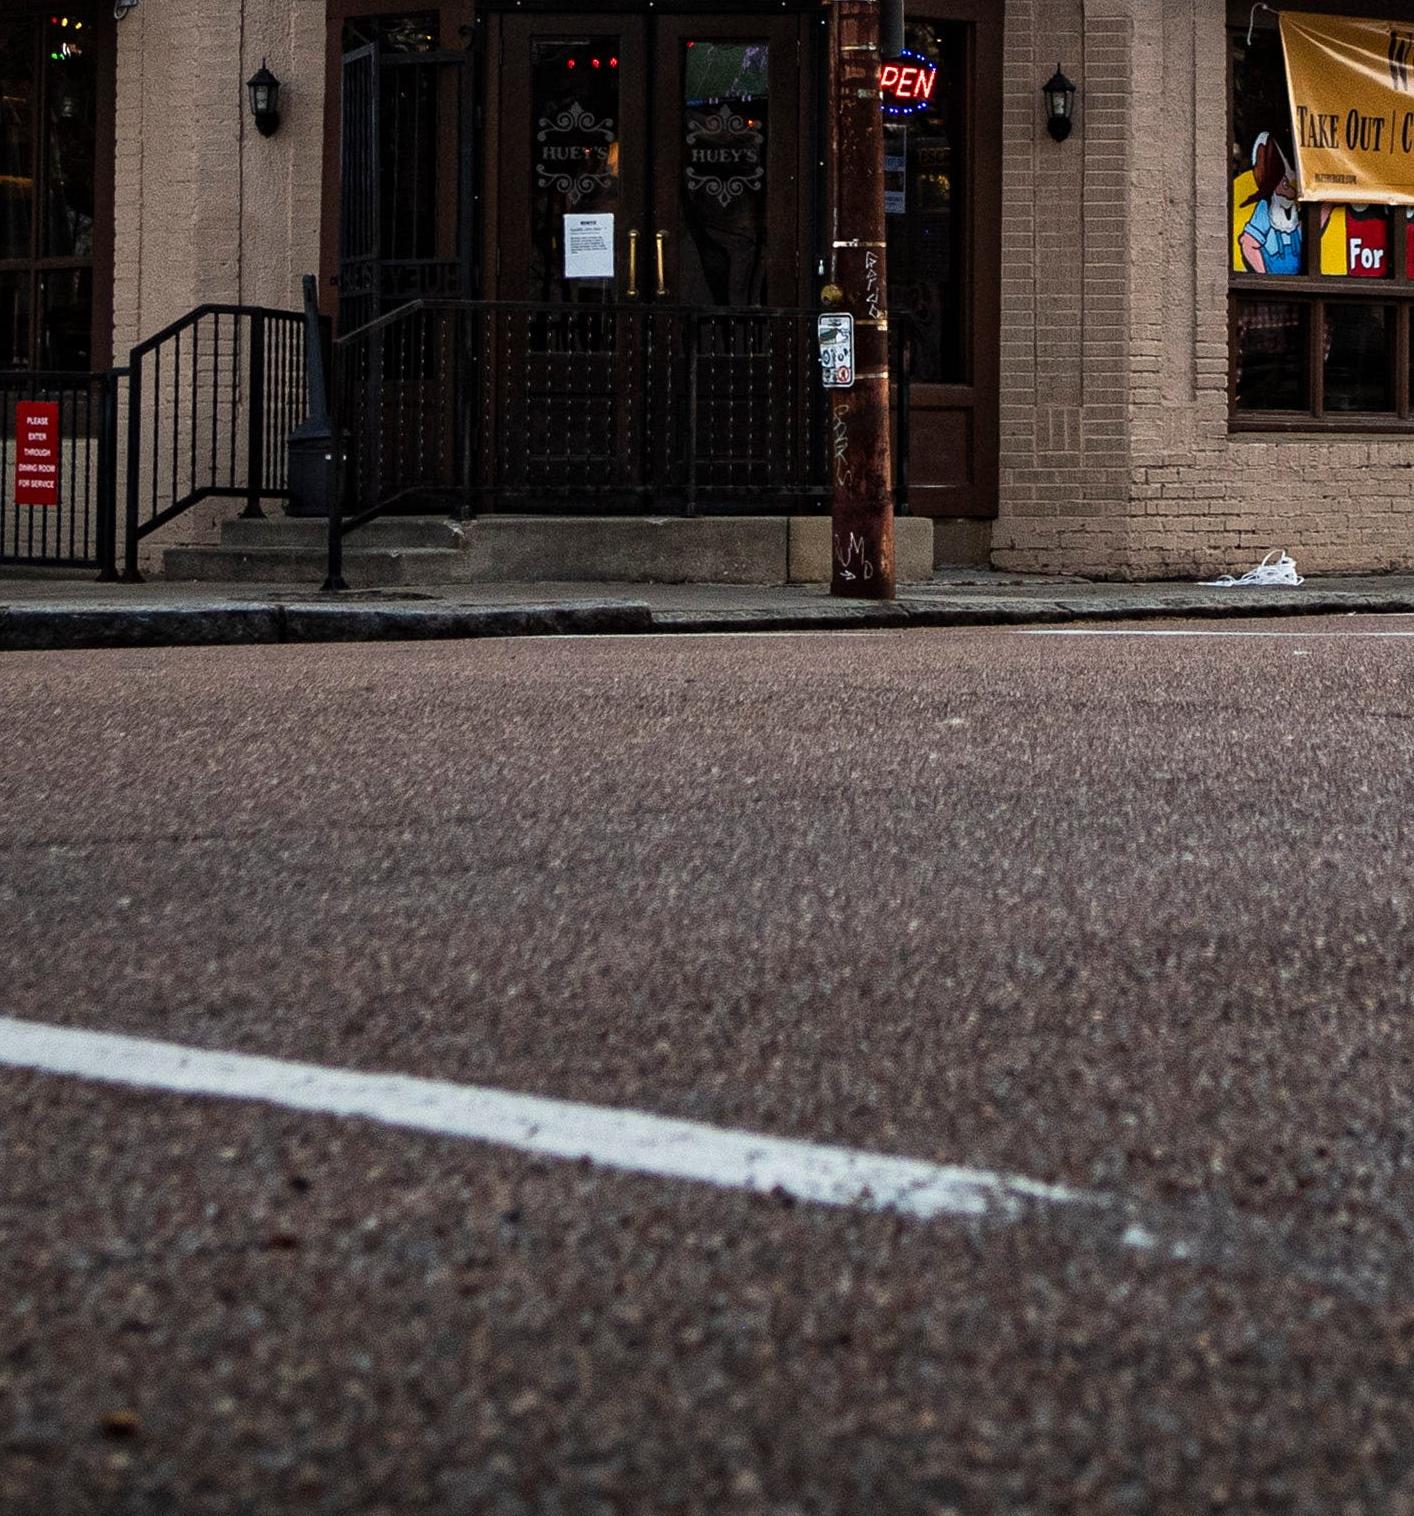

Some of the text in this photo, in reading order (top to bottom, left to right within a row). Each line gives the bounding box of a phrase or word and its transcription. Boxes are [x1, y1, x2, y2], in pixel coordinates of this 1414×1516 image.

[880, 65, 936, 99] PEN
[1296, 104, 1340, 149] TAKE
[1345, 108, 1385, 152] OUT
[542, 145, 608, 160] HUEY'S
[691, 148, 758, 163] HUEY'S
[1349, 238, 1385, 270] For
[26, 416, 49, 425] PLEASE
[27, 432, 47, 441] ENTER
[23, 447, 51, 457] THROUGH
[17, 463, 56, 473] DINING ROOM
[18, 479, 55, 489] FOR SERVICE
